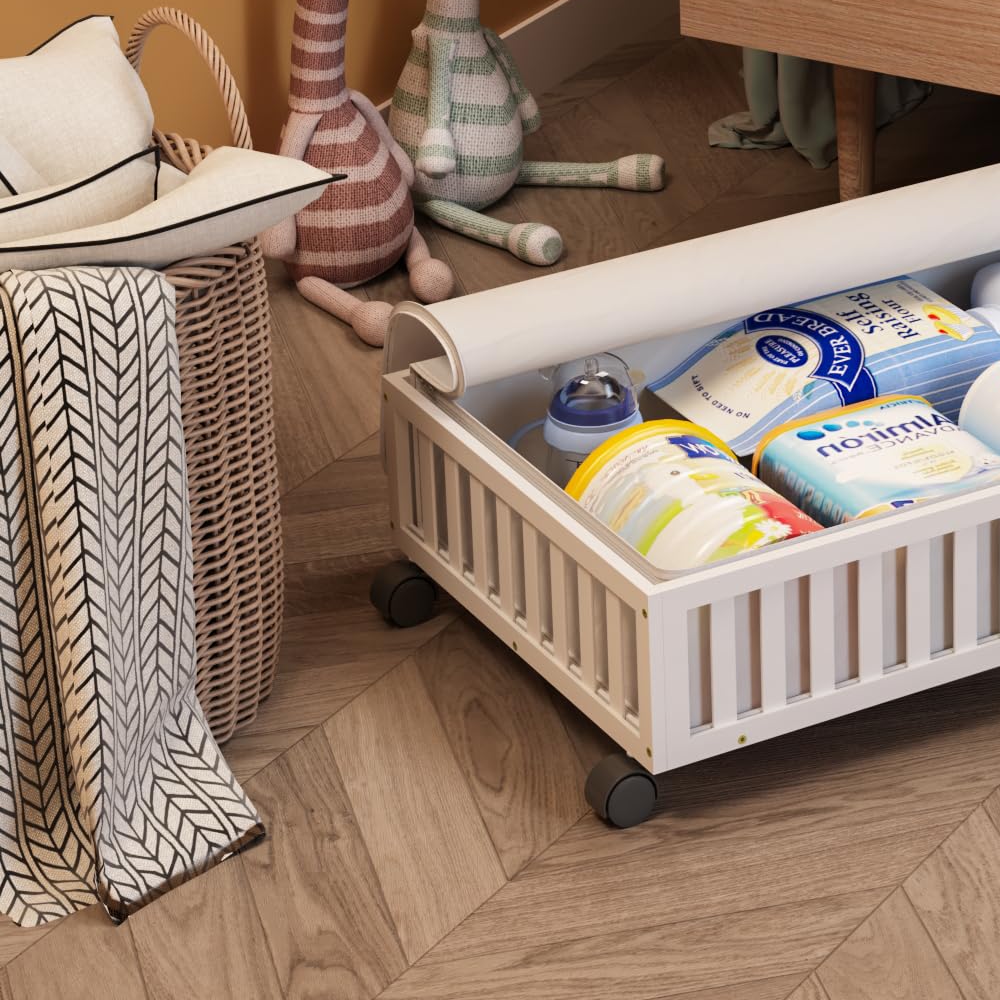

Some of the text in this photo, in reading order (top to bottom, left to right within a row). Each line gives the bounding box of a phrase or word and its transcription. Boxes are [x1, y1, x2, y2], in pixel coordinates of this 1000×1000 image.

[836, 310, 884, 334] Self
[846, 292, 921, 339] Raising
[882, 299, 922, 323] Flour
[753, 313, 852, 376] EVER BREAD
[765, 339, 801, 363] PLEASURE
[691, 374, 751, 419] NO NEED TO SIFT
